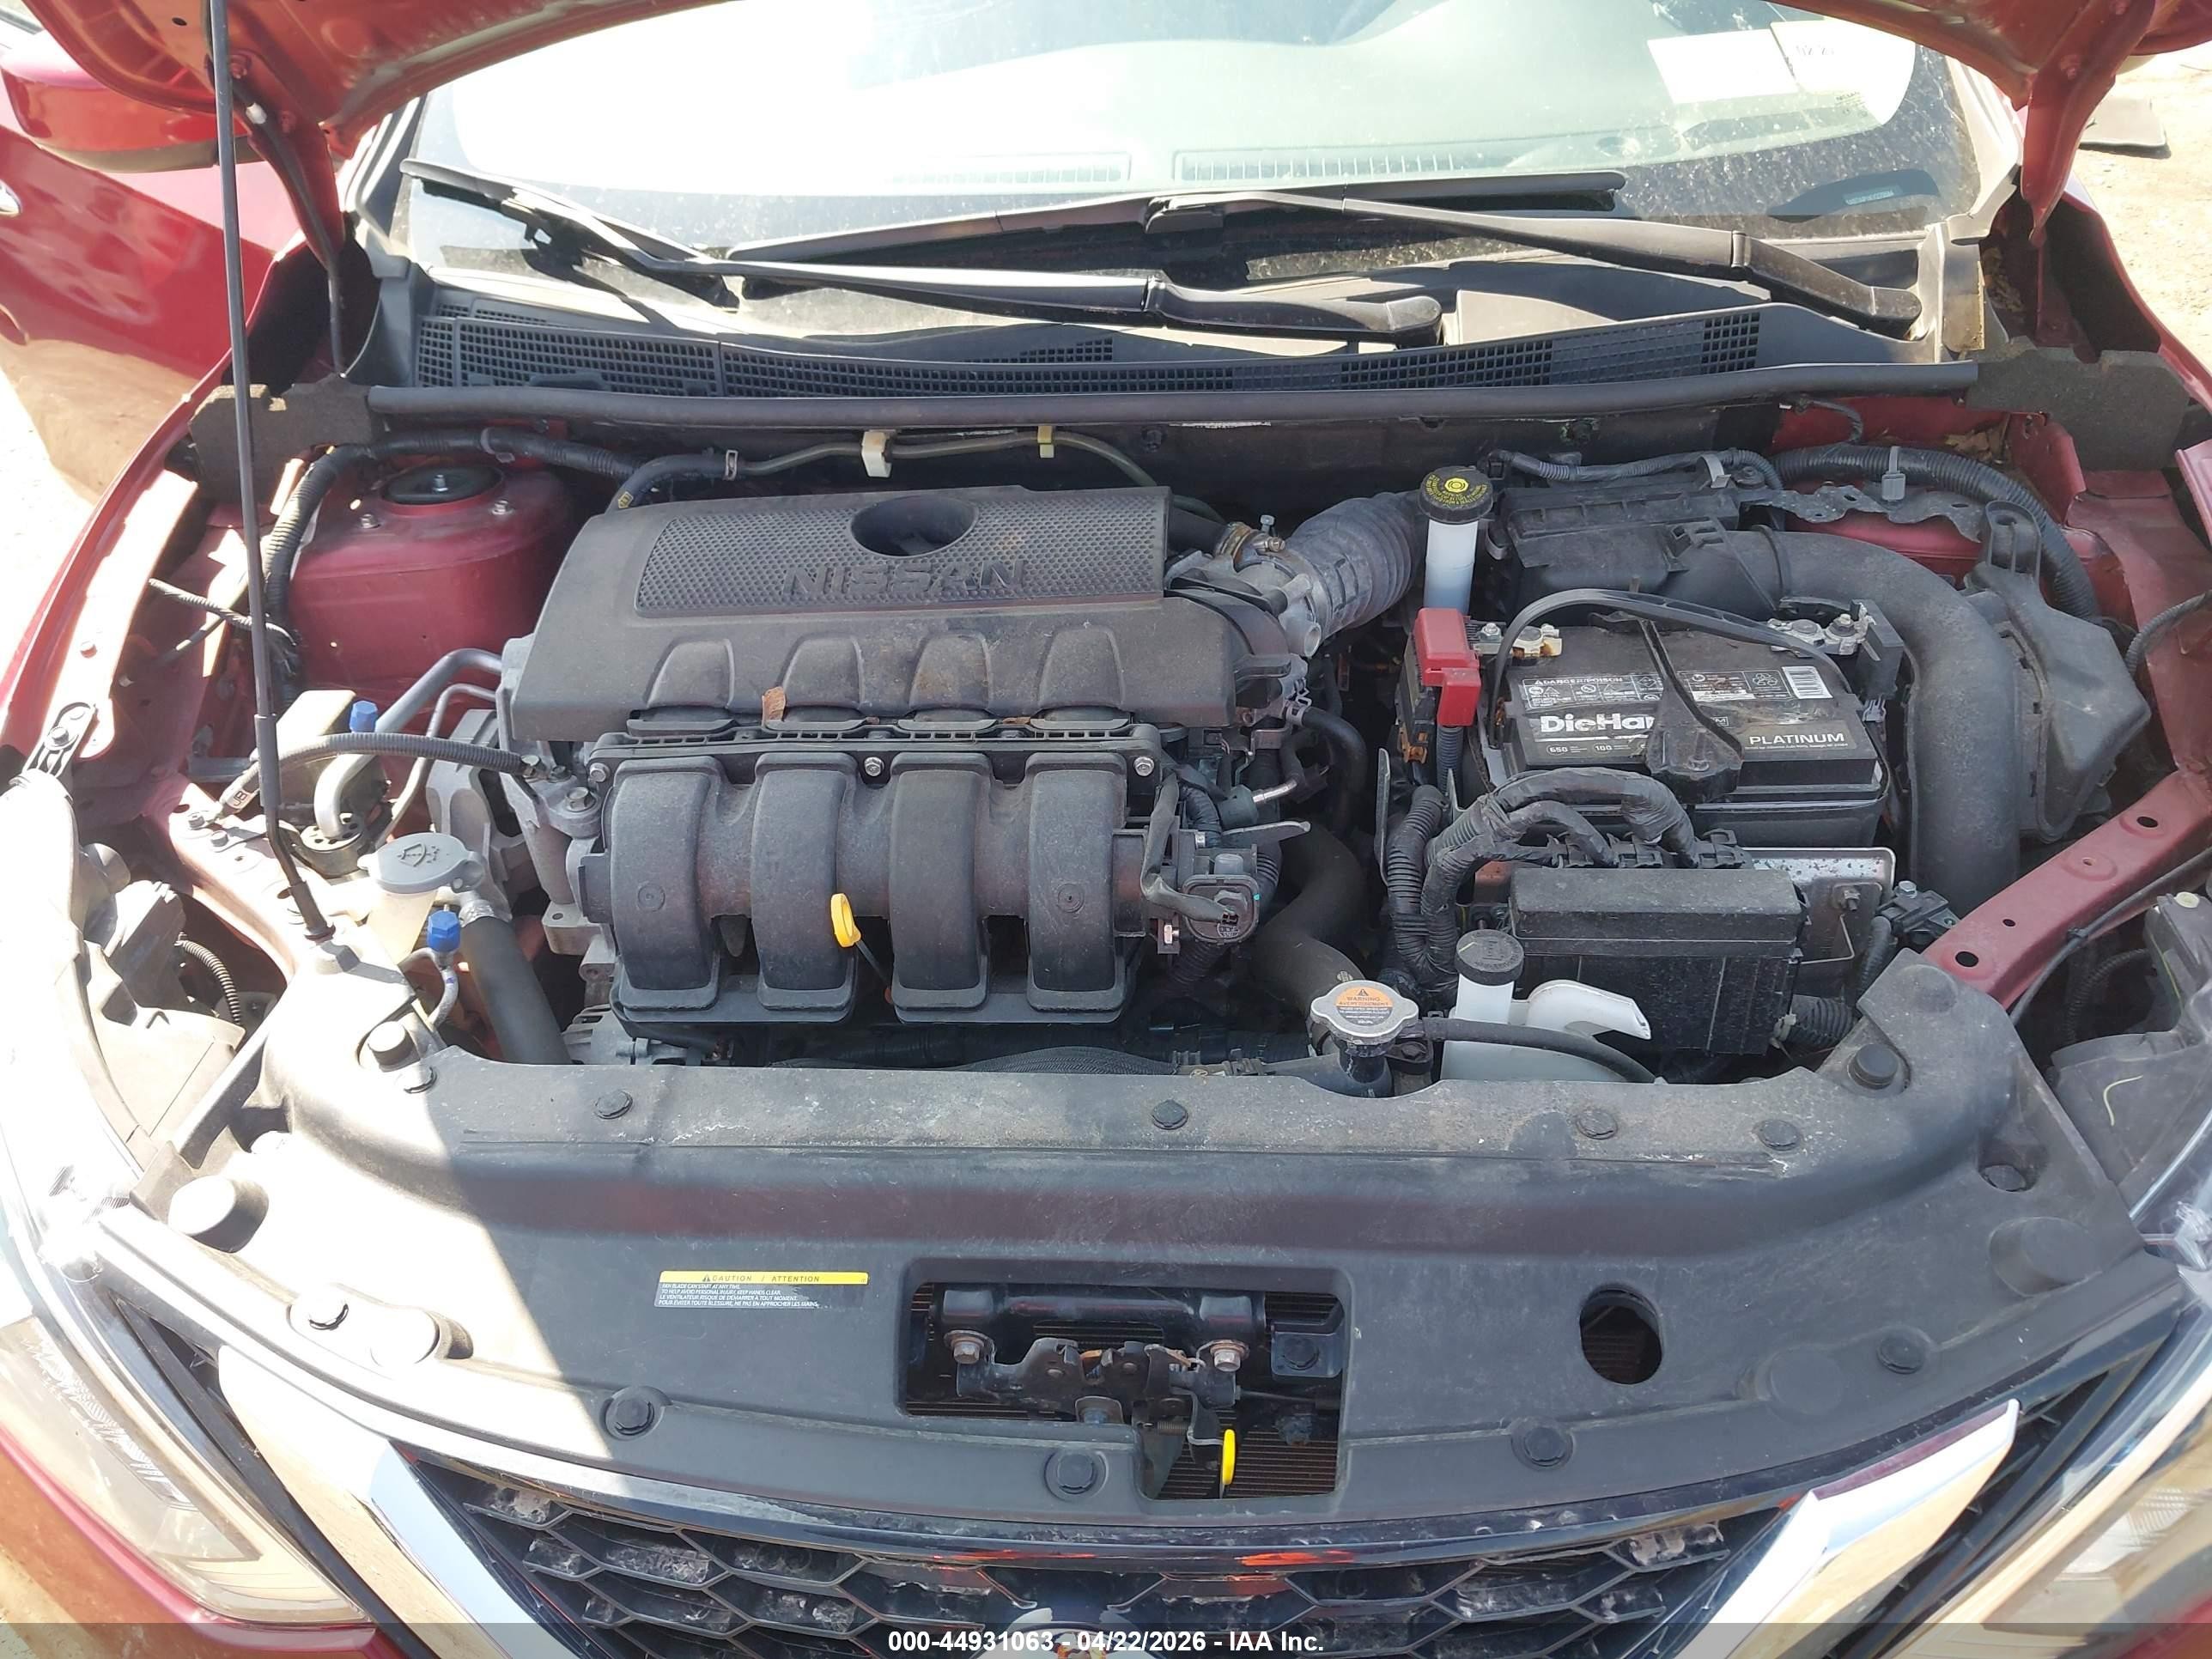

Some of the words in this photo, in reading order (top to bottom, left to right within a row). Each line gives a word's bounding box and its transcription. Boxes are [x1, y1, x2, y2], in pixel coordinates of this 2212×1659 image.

[782, 560, 1027, 596] NISSAN
[1749, 733, 1845, 744] PLATINUM
[233, 790, 248, 806] JB
